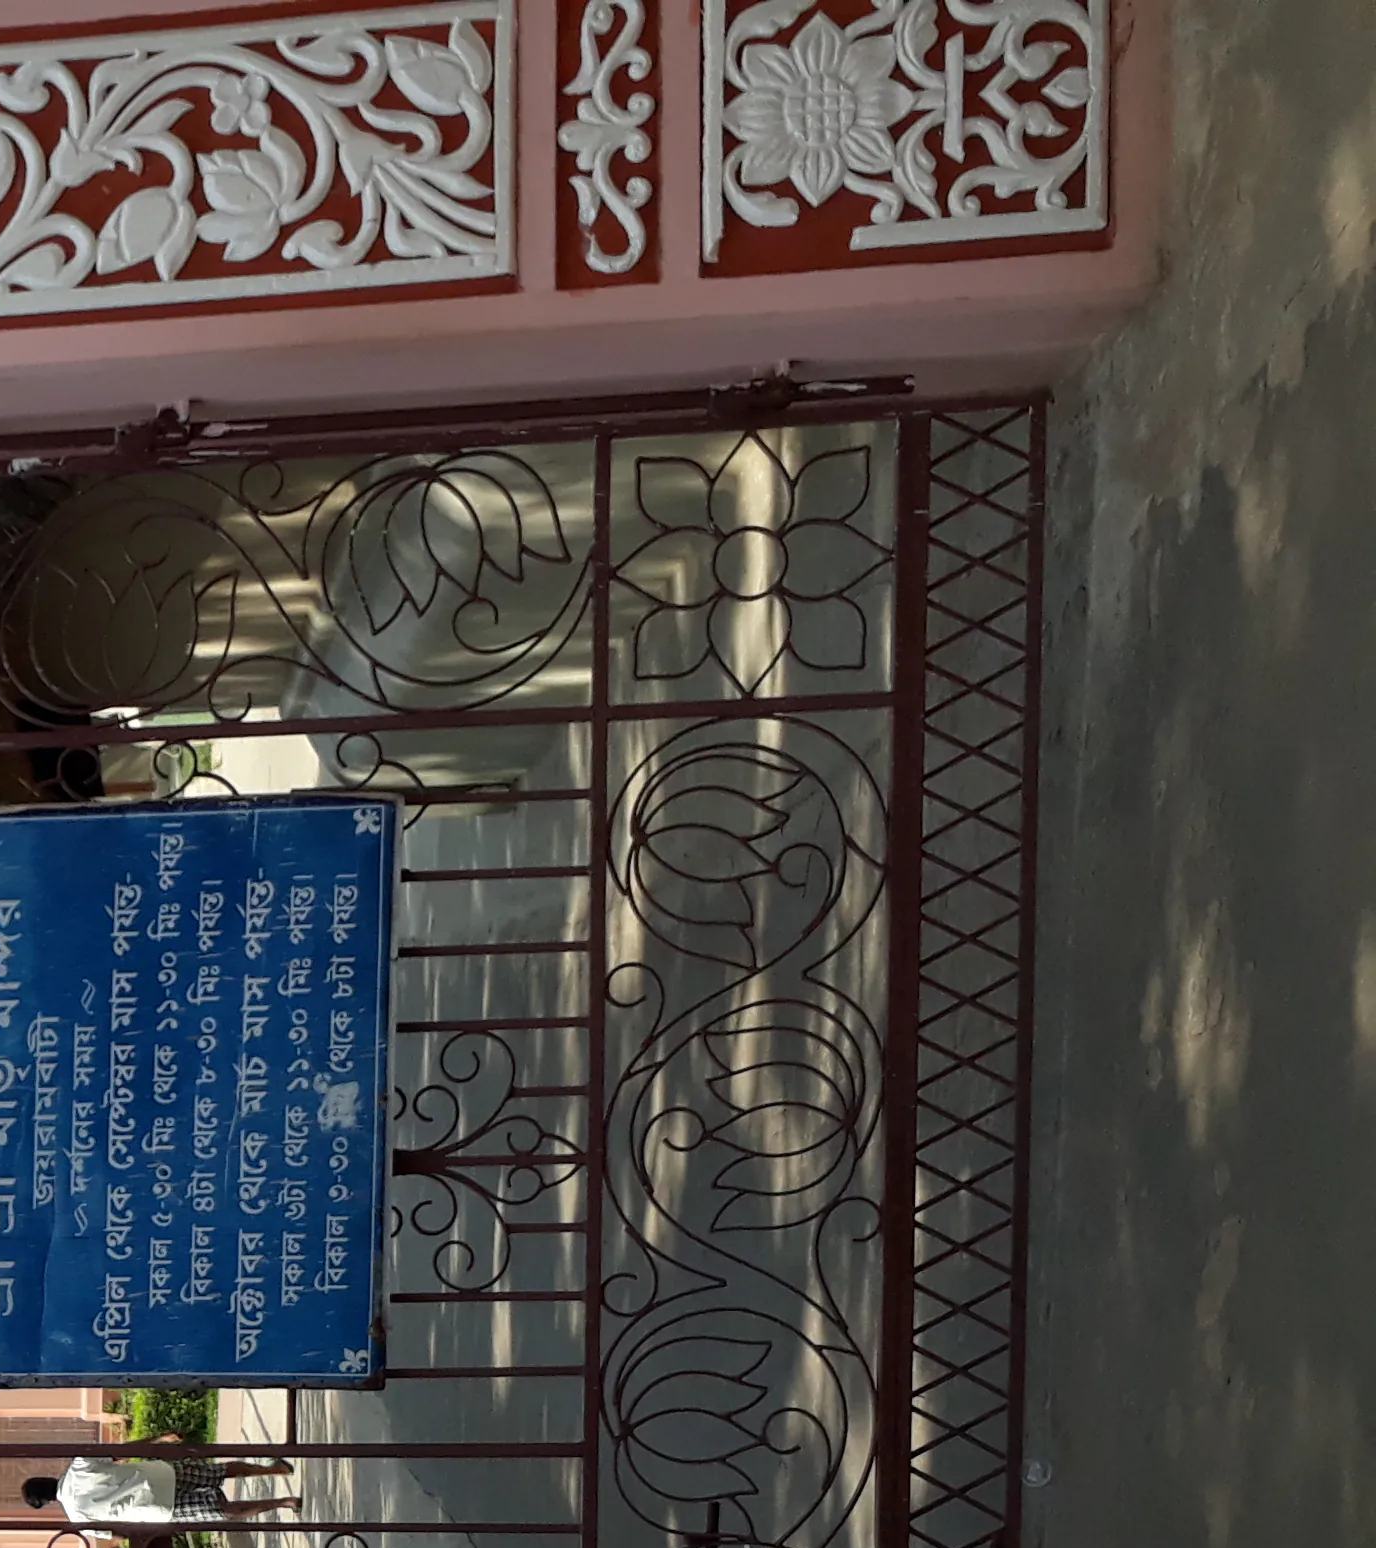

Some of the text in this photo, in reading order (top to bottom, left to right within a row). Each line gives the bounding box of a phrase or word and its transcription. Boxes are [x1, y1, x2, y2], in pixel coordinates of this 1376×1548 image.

[108, 969, 139, 1033] মাস
[155, 951, 179, 1031] ১১-৩০
[240, 974, 271, 1043] মাস
[324, 955, 356, 998] ৮টা
[151, 1044, 178, 1104] থেকে
[195, 1016, 217, 1084] ৮-৩০
[286, 1008, 310, 1091] ১১-৩০
[329, 1009, 354, 1072] থেকে
[27, 1011, 60, 1209] জয়রামবাটী
[63, 1022, 97, 1195] দর্শনের সময়
[100, 1042, 138, 1169] সেপ্টেম্বর
[233, 1052, 269, 1117] মার্চ
[192, 1096, 218, 1159] থেকে
[283, 1104, 309, 1167] থেকে
[185, 1170, 216, 1212] ৪টা
[237, 1130, 268, 1215] থেকে
[277, 1178, 307, 1221] ৬টা
[104, 1183, 134, 1260] থেকে
[314, 1212, 350, 1294] বিকাল
[147, 1237, 173, 1308] সকাল
[180, 1224, 216, 1305] বিকাল
[227, 1228, 265, 1363] অক্টোবর
[280, 1231, 307, 1307] সকাল
[92, 1272, 132, 1363] এপ্রিল
